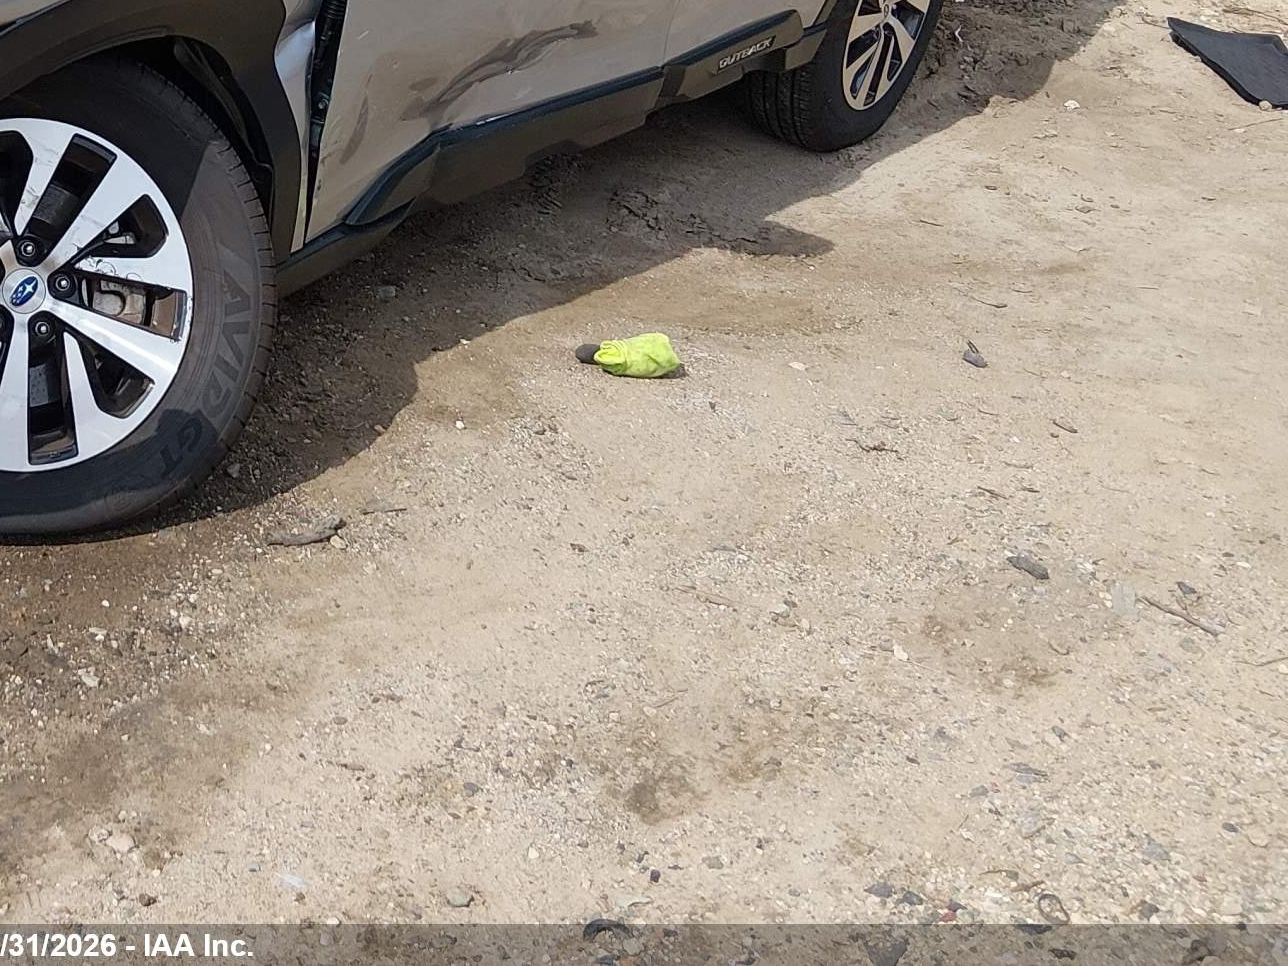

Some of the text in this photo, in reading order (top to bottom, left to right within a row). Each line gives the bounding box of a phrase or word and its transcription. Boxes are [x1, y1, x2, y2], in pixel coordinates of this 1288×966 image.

[719, 37, 772, 68] OUTBACK
[160, 268, 251, 476] AVID GT
